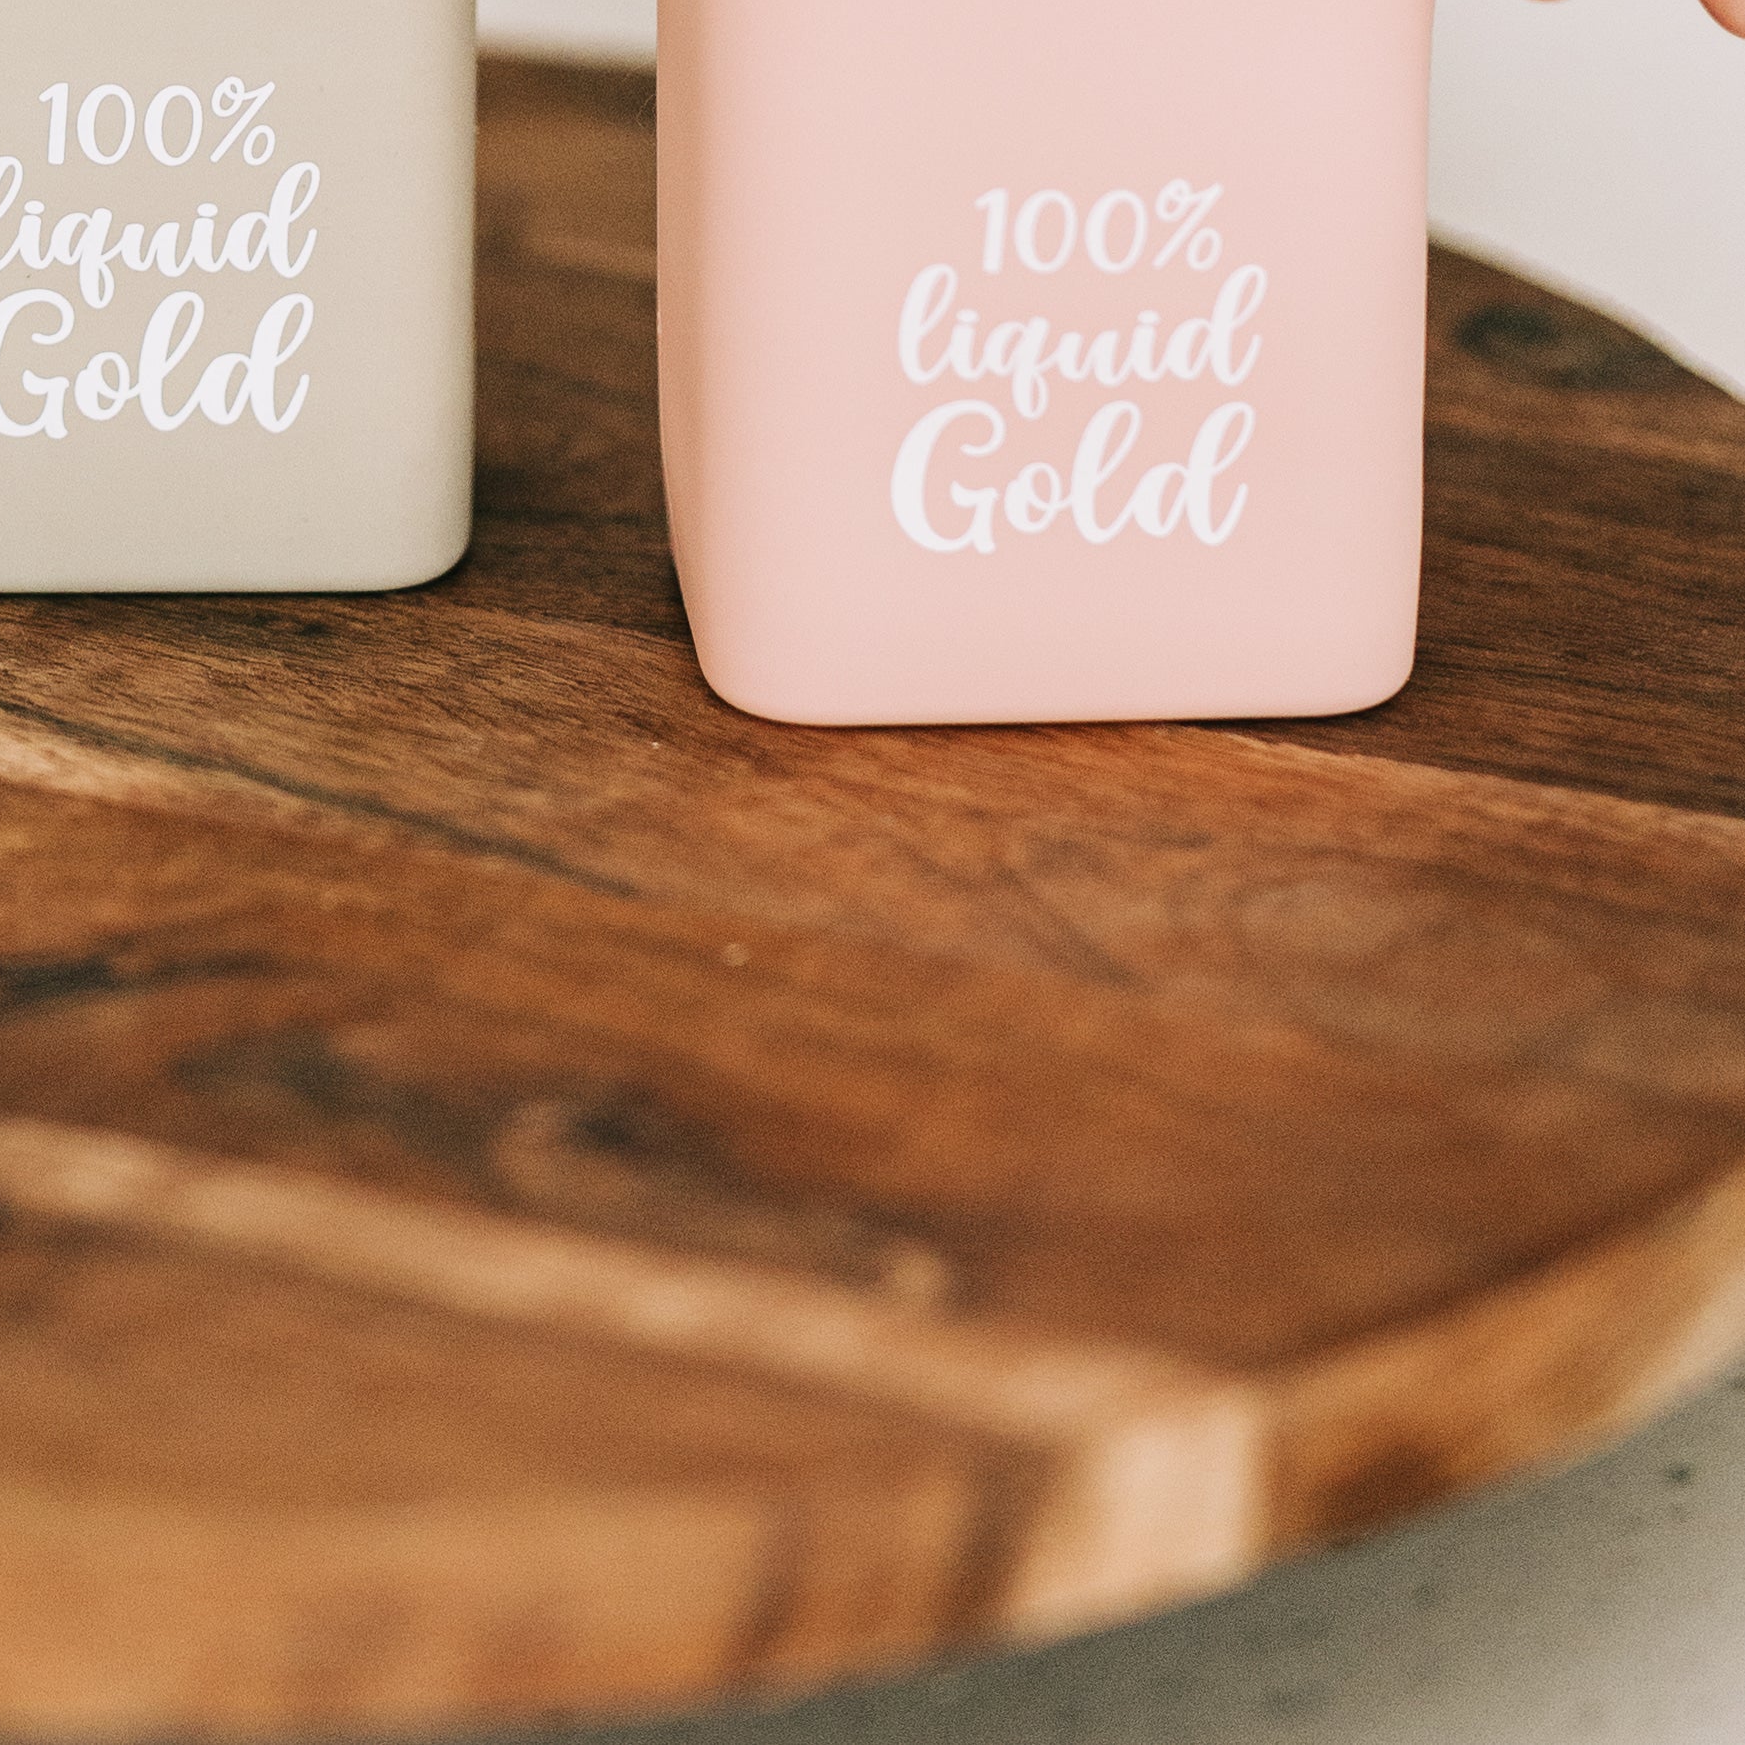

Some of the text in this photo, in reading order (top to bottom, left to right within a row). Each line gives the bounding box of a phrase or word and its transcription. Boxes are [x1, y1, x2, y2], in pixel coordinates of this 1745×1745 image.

[39, 76, 276, 166] 100%
[973, 178, 1224, 275] 100%
[898, 262, 1269, 420] liquid
[890, 399, 1257, 554] Gold
